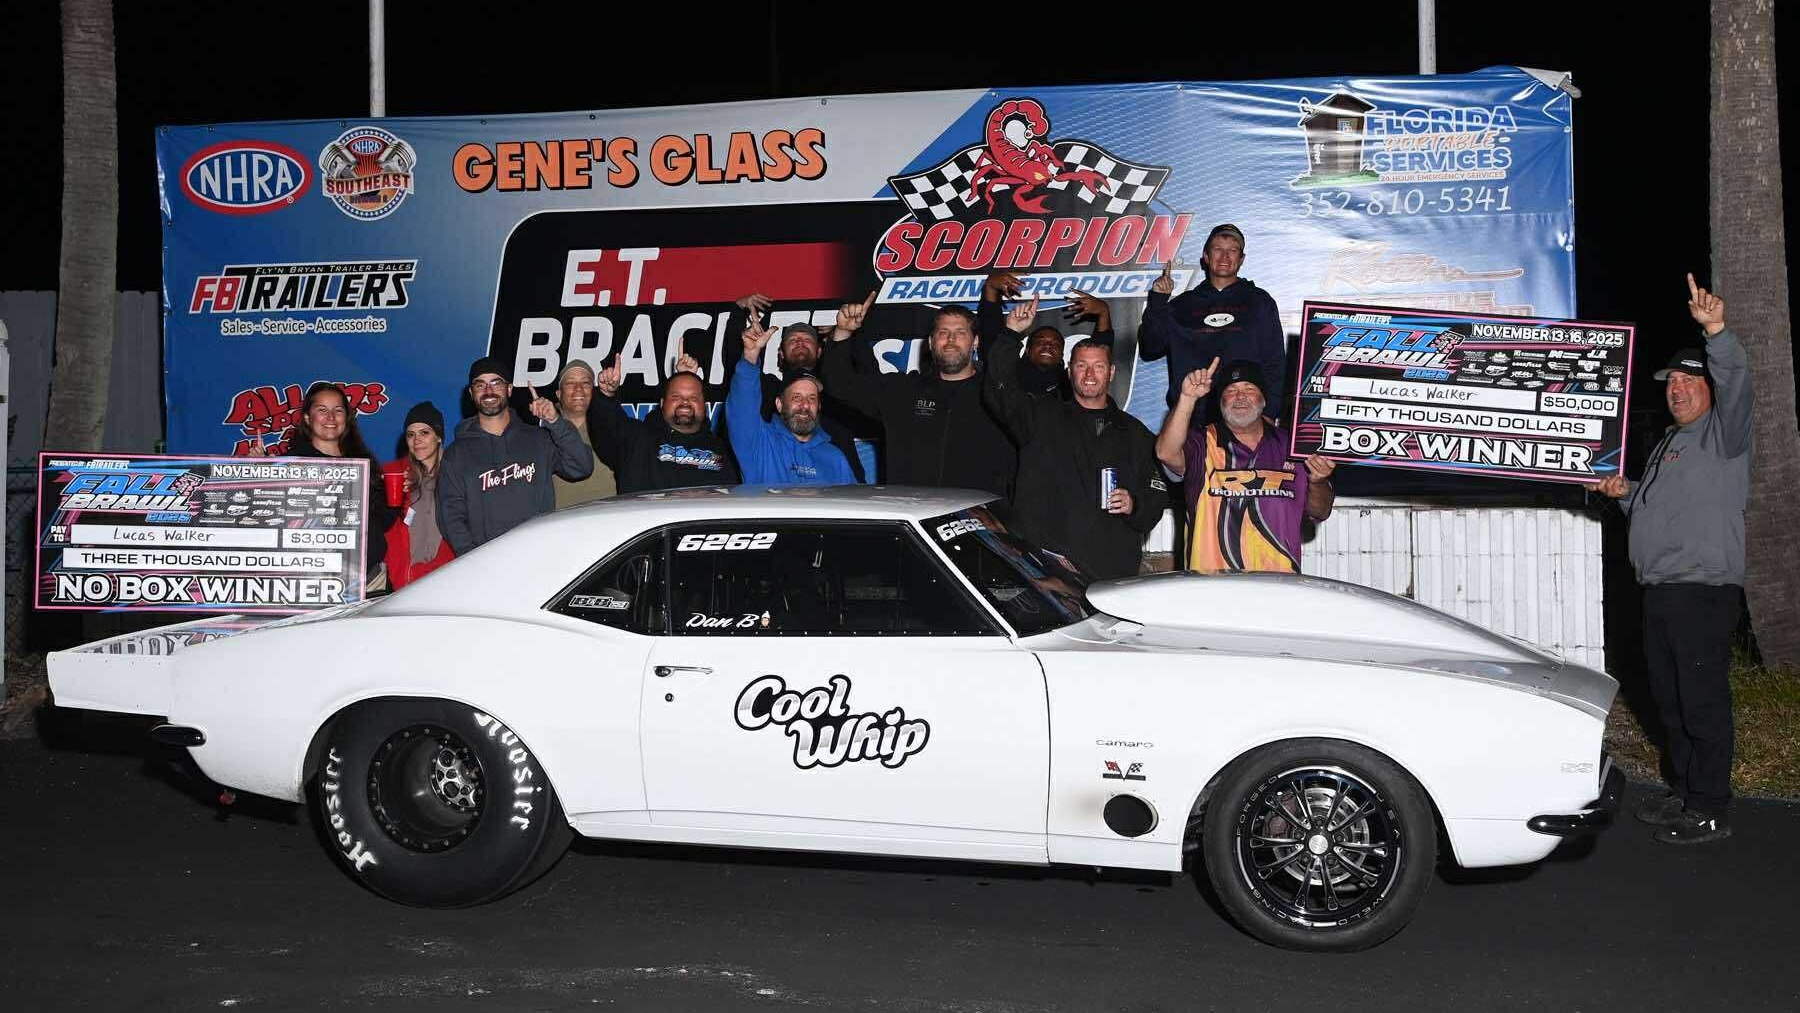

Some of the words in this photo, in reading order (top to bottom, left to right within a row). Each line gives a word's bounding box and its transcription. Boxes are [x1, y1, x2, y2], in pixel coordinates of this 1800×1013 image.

[1366, 106, 1518, 135] FLORIDA
[354, 141, 380, 153] NHRA
[1386, 131, 1495, 151] PORTABLE
[452, 136, 639, 194] GENE'S
[650, 128, 827, 186] GLASS
[1374, 147, 1512, 173] SERVICES
[200, 153, 294, 202] NHRA
[326, 173, 410, 194] SOUTHEAST
[1417, 172, 1464, 181] EMERGENCY
[1466, 171, 1505, 179] SERVICES
[1298, 186, 1512, 218] 352-810-5341
[875, 213, 1190, 272] SCORPION
[329, 264, 372, 272] TRAILER
[377, 263, 411, 271] SALES
[561, 246, 667, 307] E.T.
[888, 277, 988, 299] RACIN
[1019, 274, 1182, 294] PRODUCT
[222, 319, 252, 334] Sales
[263, 319, 305, 333] Service
[316, 317, 385, 332] Accessories
[1473, 325, 1549, 341] NOVEMBER
[1551, 330, 1585, 344] 13-16,
[1587, 333, 1623, 345] 2025
[1325, 327, 1439, 353] FALL
[1323, 346, 1450, 368] BRAWL
[1311, 376, 1326, 385] PAY
[1313, 384, 1323, 392] TO
[1370, 380, 1418, 397] Lucas
[1543, 396, 1615, 411] $50,000
[1336, 404, 1384, 418] FIFTY
[1388, 408, 1493, 427] THOUSAND
[1498, 417, 1586, 434] DOLLARS
[1324, 425, 1411, 457] BOX
[1416, 431, 1590, 473] WINNER
[212, 465, 287, 479] NOVEMBER
[324, 468, 358, 480] 2025
[501, 462, 536, 486] Flings
[1210, 470, 1295, 491] RT
[64, 473, 178, 496] FALL
[62, 494, 191, 511] BRAWL
[51, 525, 67, 534] PAY
[52, 534, 64, 542] TO
[113, 527, 155, 541] Lucas
[291, 532, 348, 545] $3,000
[936, 518, 987, 542] 6262
[677, 533, 778, 552] 6262
[81, 553, 138, 565] THREE
[142, 554, 241, 567] THOUSAND
[245, 556, 325, 568] DOLLARS
[56, 574, 112, 602] NO
[116, 574, 195, 602] BOX
[198, 575, 345, 604] WINNER
[686, 612, 734, 628] Dan
[736, 613, 760, 628] B
[734, 674, 851, 731] Cool
[785, 707, 930, 769] Whip
